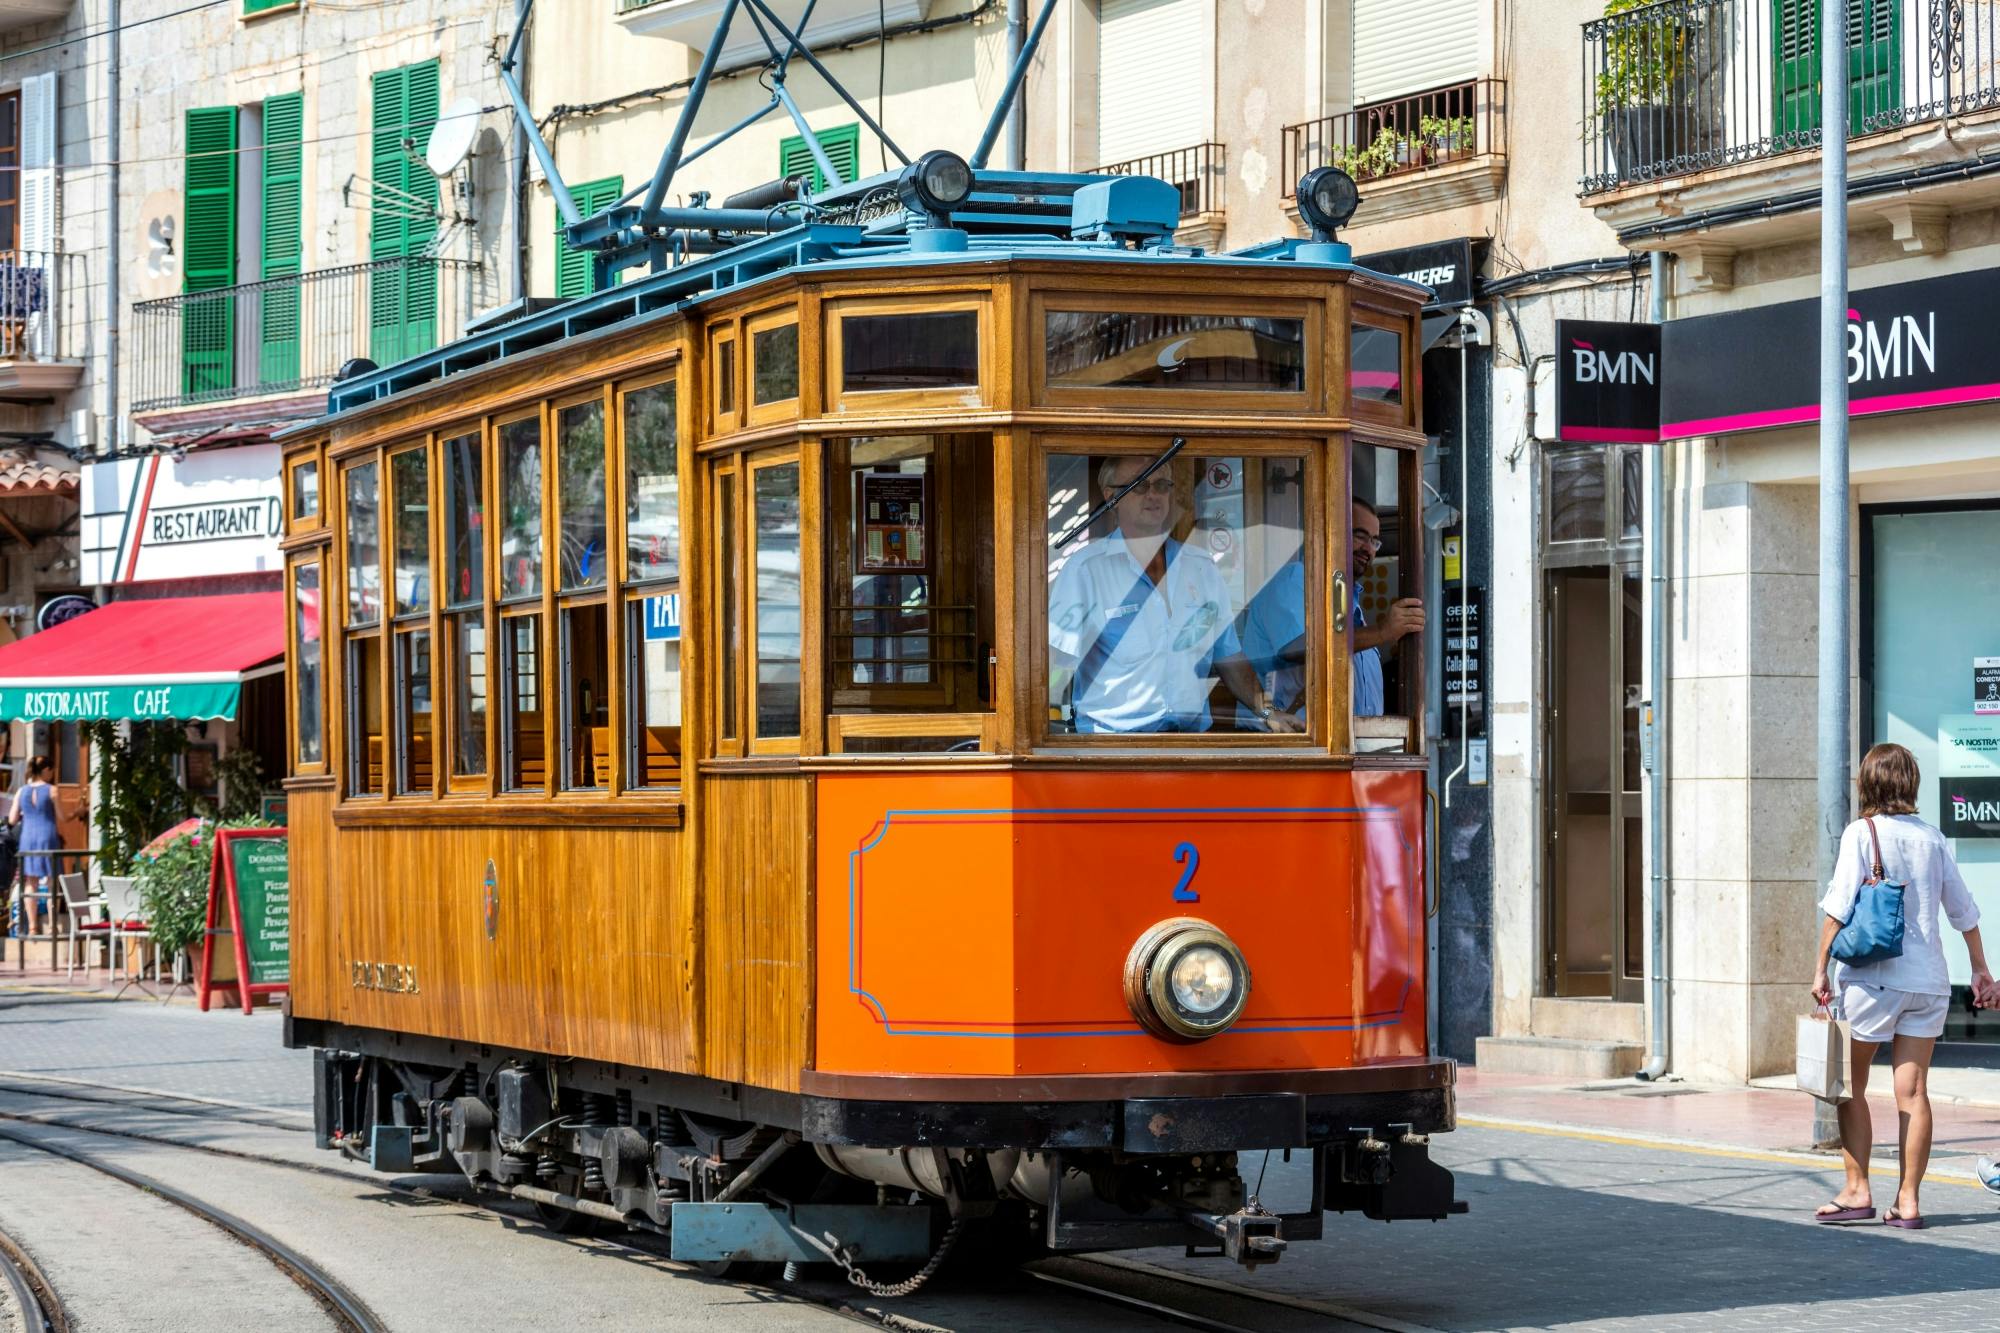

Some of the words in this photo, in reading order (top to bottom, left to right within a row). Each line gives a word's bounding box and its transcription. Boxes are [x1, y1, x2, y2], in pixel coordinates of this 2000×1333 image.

[1848, 311, 1935, 384] BMN
[1572, 348, 1654, 386] BMN
[153, 505, 261, 541] RESTAURANT
[25, 692, 109, 717] RISTORANTE
[134, 687, 171, 716] CAFÉ
[1452, 680, 1478, 690] crcs
[1953, 801, 2000, 822] BMN
[1172, 841, 1200, 903] 2
